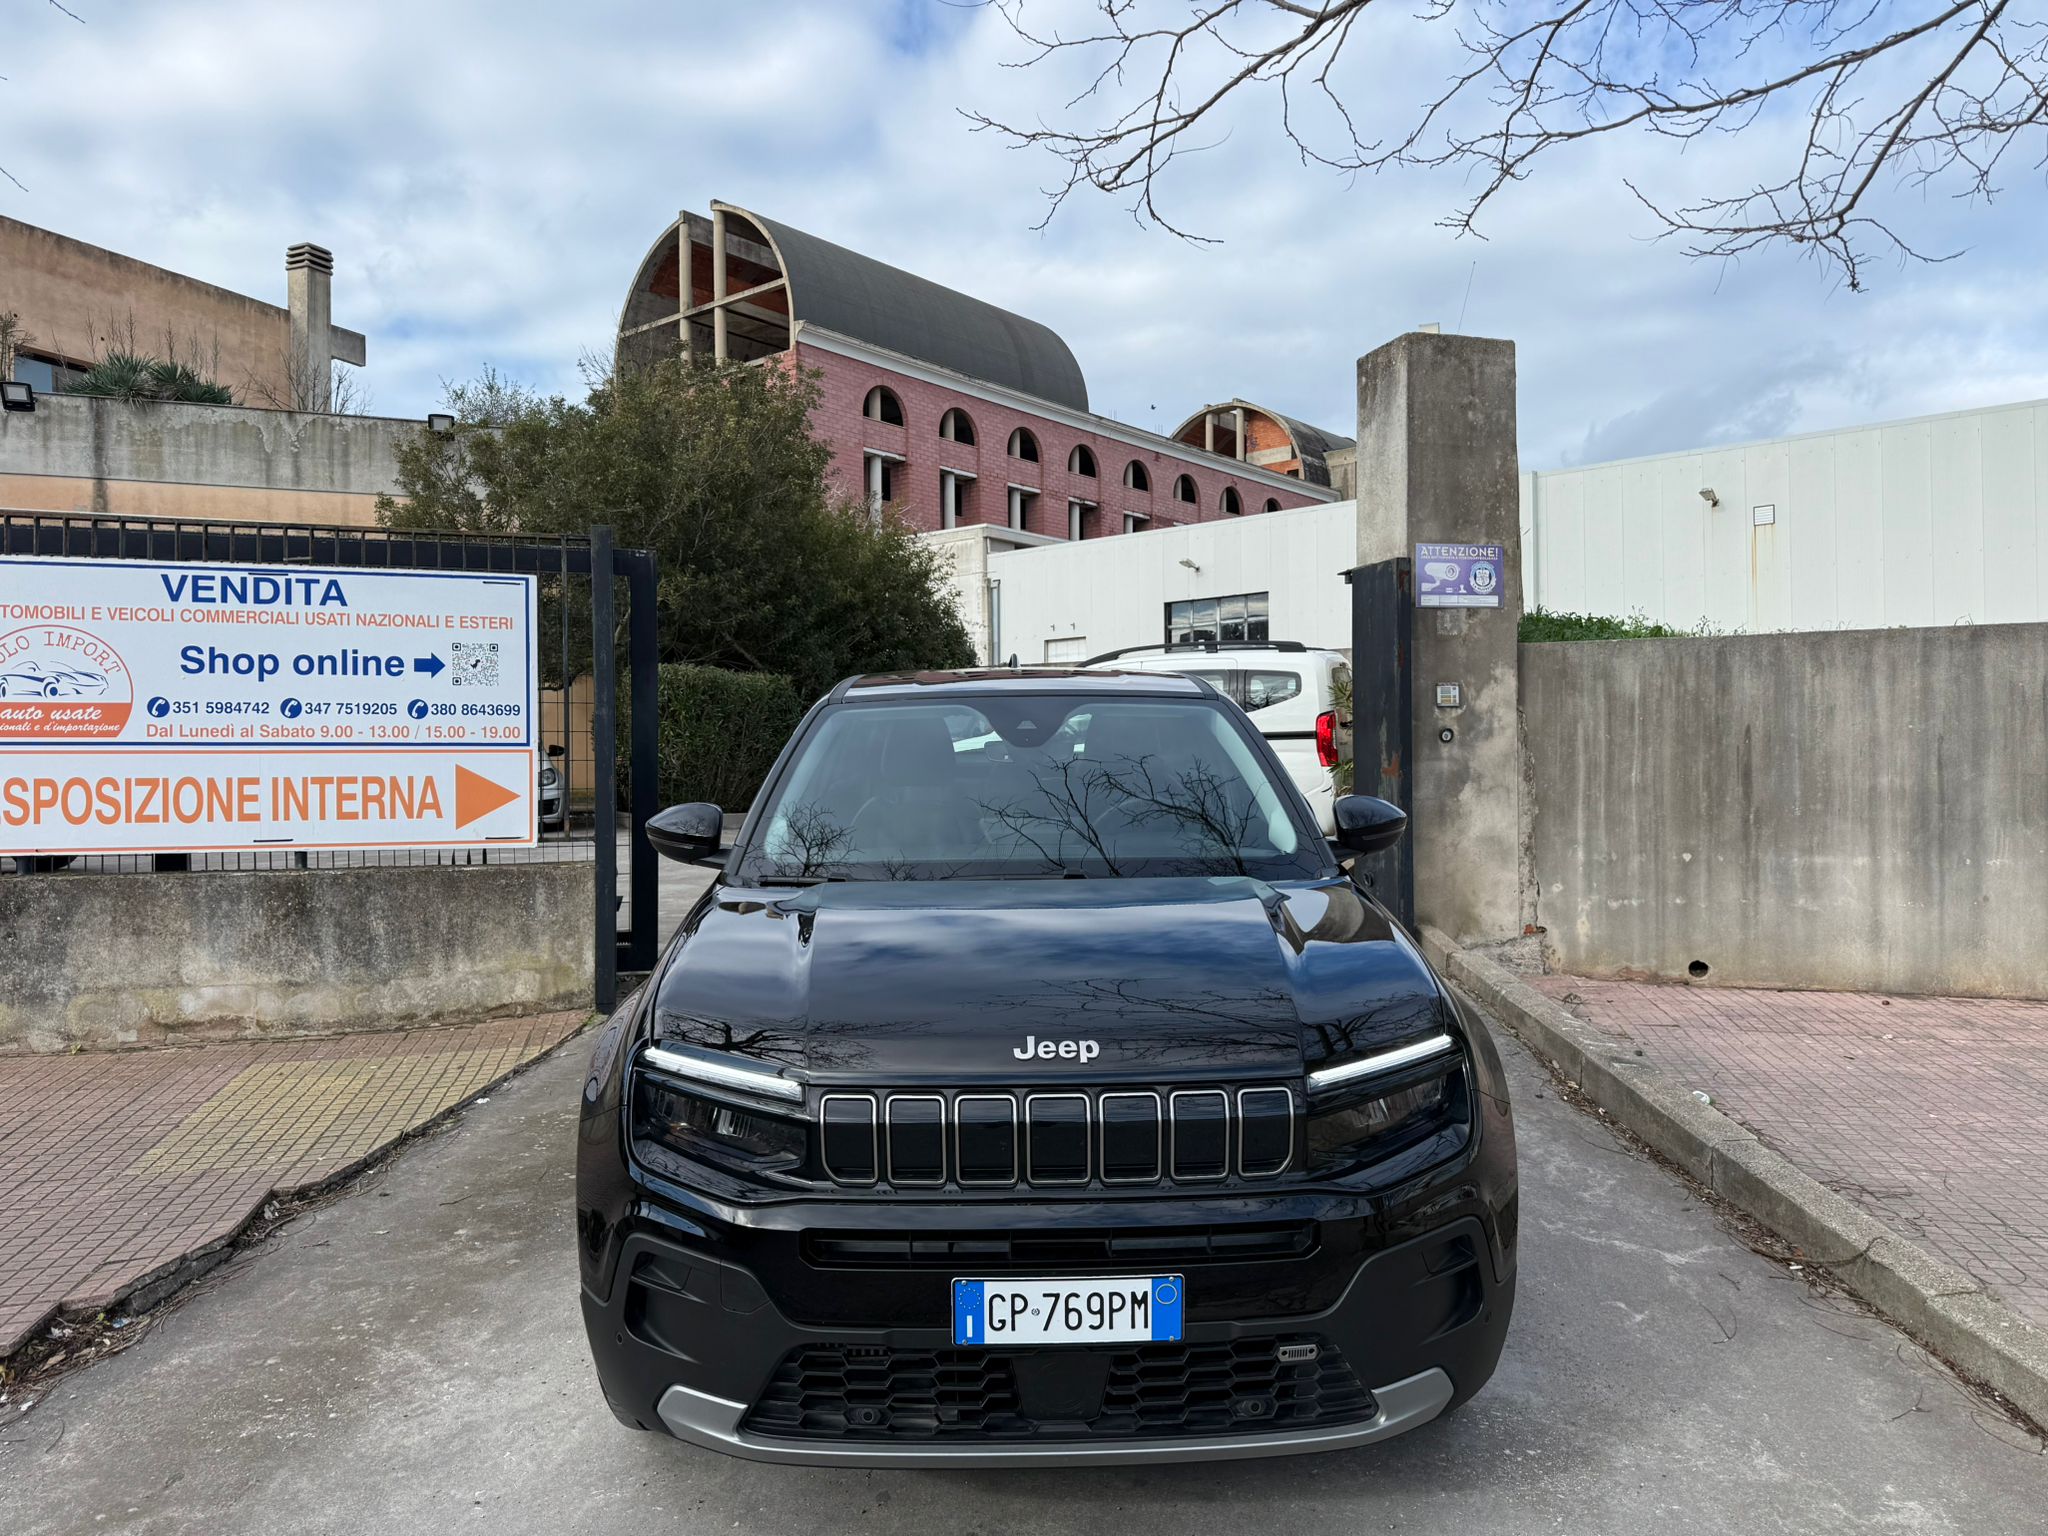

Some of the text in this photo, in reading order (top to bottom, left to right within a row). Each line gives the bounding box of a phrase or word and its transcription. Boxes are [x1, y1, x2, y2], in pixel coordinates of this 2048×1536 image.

[1421, 546, 1498, 557] ATTENZIONE!
[161, 573, 348, 607] VENDITA
[0, 604, 513, 630] TOMOBILI E VEICOLI COMMERCIALI USATI NAZIONALI E ESTERI
[43, 631, 121, 674] IMPORT
[180, 645, 405, 682] Shop online
[0, 706, 102, 720] auto usate
[172, 701, 521, 716] 351 5984742 347 7519205 380 8643699
[44, 721, 120, 735] d'importazione
[147, 724, 173, 738] Dal
[179, 723, 235, 738] Lunedì
[240, 724, 254, 738] al
[259, 724, 316, 738] Sabato
[320, 725, 353, 738] 9.00
[369, 725, 410, 738] 13.00
[425, 726, 466, 739] 15.00
[481, 726, 521, 739] 19.00
[0, 775, 444, 826] SPOSIZIONE INTERNA
[1013, 1035, 1100, 1063] Jeep
